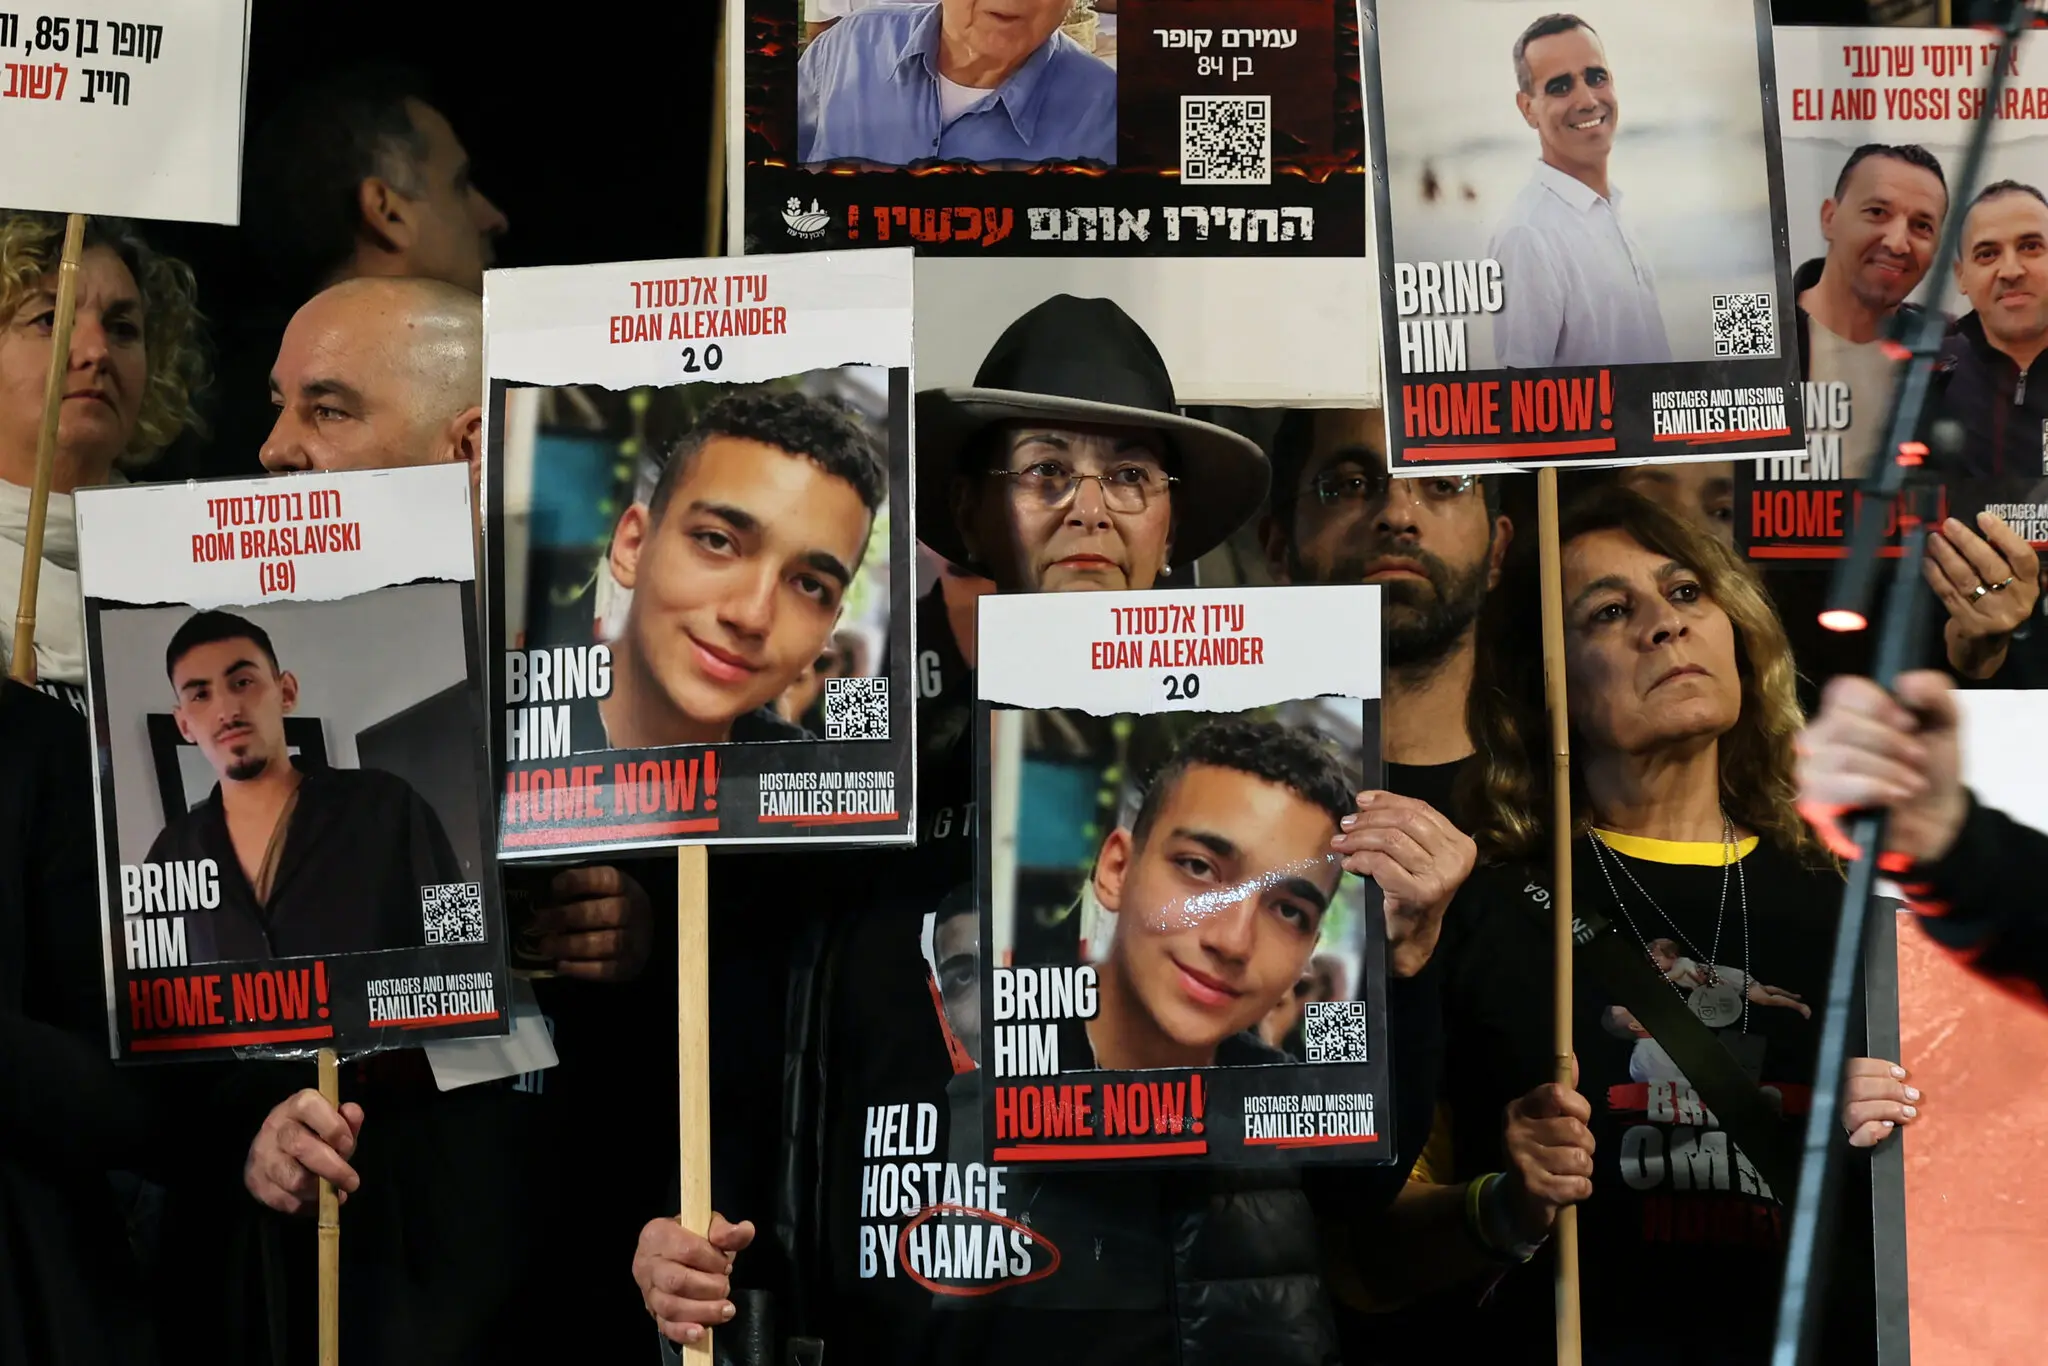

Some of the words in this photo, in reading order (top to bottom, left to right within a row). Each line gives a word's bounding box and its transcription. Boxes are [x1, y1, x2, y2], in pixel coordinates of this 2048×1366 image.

[24, 15, 71, 57] 85,
[75, 18, 99, 59] בן
[106, 21, 164, 64] קופר
[1152, 29, 1213, 54] קופר
[1221, 28, 1297, 49] עמירם
[1197, 55, 1223, 76] 84
[1232, 56, 1255, 82] בן
[1844, 45, 1915, 78] שרעבי
[1922, 45, 1973, 77] ויוסי
[2, 62, 69, 101] לשוב
[79, 68, 130, 106] חייב
[1792, 88, 1824, 121] ELI
[1831, 88, 1878, 121] AND
[1884, 87, 1951, 121] YOSSI
[1957, 87, 2048, 120] SHARAB
[873, 205, 1014, 247] עכשיו
[1027, 206, 1151, 242] אותם
[1162, 206, 1314, 243] החזירו
[631, 276, 718, 309] אלכסנדר
[725, 274, 768, 306] עידן
[1395, 257, 1503, 315] BRING
[610, 315, 663, 344] EDAN
[667, 306, 787, 341] ALEXANDER
[681, 343, 723, 373] 20
[1398, 318, 1467, 374] HIM
[1402, 381, 1502, 438] HOME
[1510, 368, 1614, 433] NOW!
[1652, 390, 1709, 410] HOSTAGES
[1710, 389, 1733, 407] AND
[1734, 387, 1784, 406] MISSING
[1653, 407, 1726, 436] FAMILIES
[1727, 405, 1787, 432] FORUM
[207, 491, 304, 530] ברסלבסקי
[309, 489, 342, 520] רום
[1751, 489, 1844, 539] HOME
[192, 532, 236, 563] ROM
[240, 521, 362, 560] BRASLAVSKI
[259, 560, 296, 595] (19)
[1111, 604, 1196, 635] אלכסנדר
[1203, 604, 1245, 635] עידן
[1091, 640, 1143, 671] EDAN
[1149, 636, 1264, 668] ALEXANDER
[505, 645, 612, 703] BRING
[1162, 673, 1200, 701] 20
[505, 704, 572, 762] HIM
[506, 764, 604, 826] HOME
[614, 749, 719, 814] NOW!
[759, 772, 818, 791] HOSTAGES
[818, 771, 843, 790] AND
[844, 770, 895, 790] MISSING
[759, 788, 833, 817] FAMILIES
[835, 787, 896, 815] FORUM
[120, 858, 221, 915] BRING
[125, 916, 188, 970] HIM
[128, 977, 225, 1030] HOME
[231, 960, 331, 1023] NOW!
[366, 978, 422, 998] HOSTAGES
[422, 976, 445, 994] AND
[445, 971, 494, 992] MISSING
[992, 965, 1098, 1022] BRING
[368, 994, 438, 1022] FAMILIES
[438, 988, 496, 1017] FORUM
[993, 1023, 1060, 1078] HIM
[995, 1083, 1094, 1140] HOME
[1102, 1073, 1205, 1137] NOW!
[1243, 1095, 1301, 1115] HOSTAGES
[1300, 1095, 1324, 1113] AND
[1324, 1093, 1374, 1112] MISSING
[864, 1102, 938, 1158] HELD
[1244, 1112, 1315, 1140] FAMILIES
[1318, 1110, 1375, 1138] FORUM
[860, 1162, 1008, 1218] HOSTAGE
[860, 1224, 899, 1278] BY
[908, 1223, 1035, 1280] HAMAS
